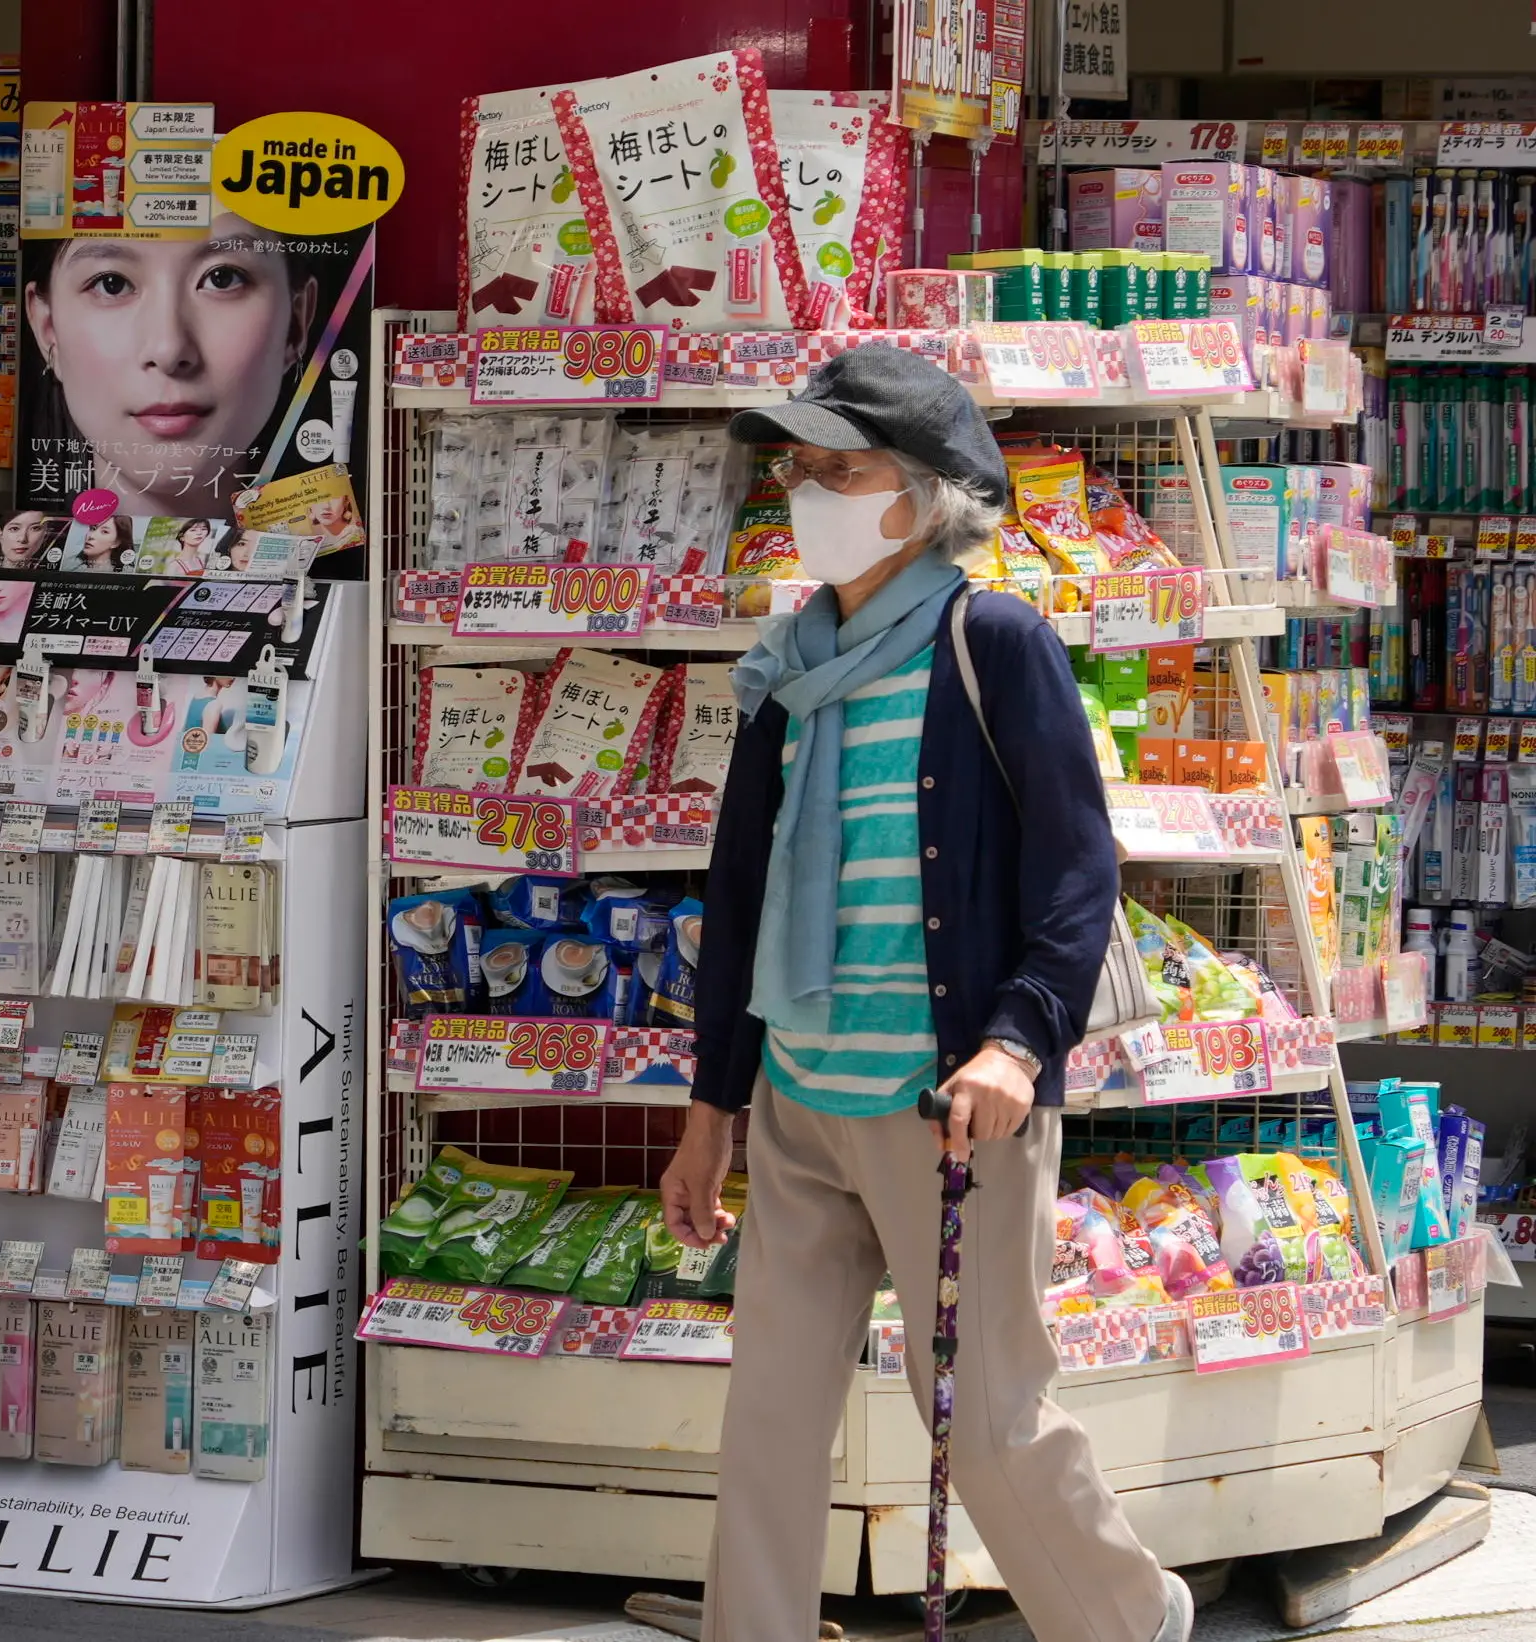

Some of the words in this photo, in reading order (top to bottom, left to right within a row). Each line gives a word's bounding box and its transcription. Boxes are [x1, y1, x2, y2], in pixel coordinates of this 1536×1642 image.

[152, 112, 195, 124] 日本限定
[1062, 121, 1125, 134] 特選品
[144, 125, 168, 135] Japan
[169, 125, 204, 134] Exclusive
[1189, 122, 1236, 150] 178
[1462, 123, 1522, 135] 特選品
[24, 143, 64, 153] ALLIE
[264, 138, 327, 158] made
[333, 139, 356, 160] in
[609, 122, 727, 164] 梅ぼしの
[143, 154, 204, 165] 春节限定包装
[221, 150, 389, 208] Japan
[615, 165, 702, 202] シート
[482, 174, 546, 208] シート
[167, 213, 197, 222] increase
[209, 239, 350, 256] つづけ、塗りたてのわたし。
[1413, 317, 1474, 329] 特選品
[481, 330, 560, 351] お買得品
[735, 341, 795, 360] 送礼首选
[1189, 323, 1241, 367] 498
[407, 343, 457, 360] 送礼首选
[564, 329, 654, 379] 980
[605, 379, 646, 397] 1058
[468, 566, 547, 585] お買得品
[1095, 573, 1144, 598] お買得品
[411, 579, 459, 596] 送礼首选
[550, 567, 640, 613] 1000
[1148, 571, 1197, 624] 178
[34, 592, 88, 611] 美耐久
[30, 615, 138, 634] プライマーUV
[586, 613, 628, 631] 1080
[666, 605, 718, 626] 日本人气商品
[561, 682, 630, 716] 梅ぼしの
[440, 706, 506, 728] 梅ぼしの
[553, 704, 602, 731] シート
[438, 730, 482, 749] シート
[393, 788, 472, 815] お買得品
[477, 798, 566, 850] 278
[654, 826, 705, 844] 日本人气商品
[526, 851, 563, 870] 300
[204, 885, 259, 902] ALLIE
[342, 999, 354, 1063] Think
[428, 1018, 506, 1041] お買得品
[506, 1023, 598, 1071] 268
[1194, 1025, 1258, 1076] 198
[551, 1072, 588, 1091] 289
[109, 1110, 182, 1128] ALLIE
[336, 1071, 353, 1240] Sustainability,
[117, 1199, 138, 1211] 空箱
[292, 1006, 336, 1415] ALLIE
[337, 1245, 348, 1280] Be
[386, 1281, 464, 1305] お買得品
[460, 1292, 554, 1338] 438
[646, 1300, 728, 1322] お買得品
[1192, 1294, 1240, 1317] お買得品
[1241, 1289, 1296, 1338] 388
[42, 1322, 102, 1341] ALLIE
[128, 1322, 187, 1340] ALLIE
[200, 1329, 261, 1348] ALLIE
[332, 1287, 347, 1407] Beautiful.
[495, 1335, 533, 1353] 473
[78, 1354, 97, 1365] 空箱
[90, 1503, 111, 1519] Be
[115, 1506, 191, 1526] Beautiful.
